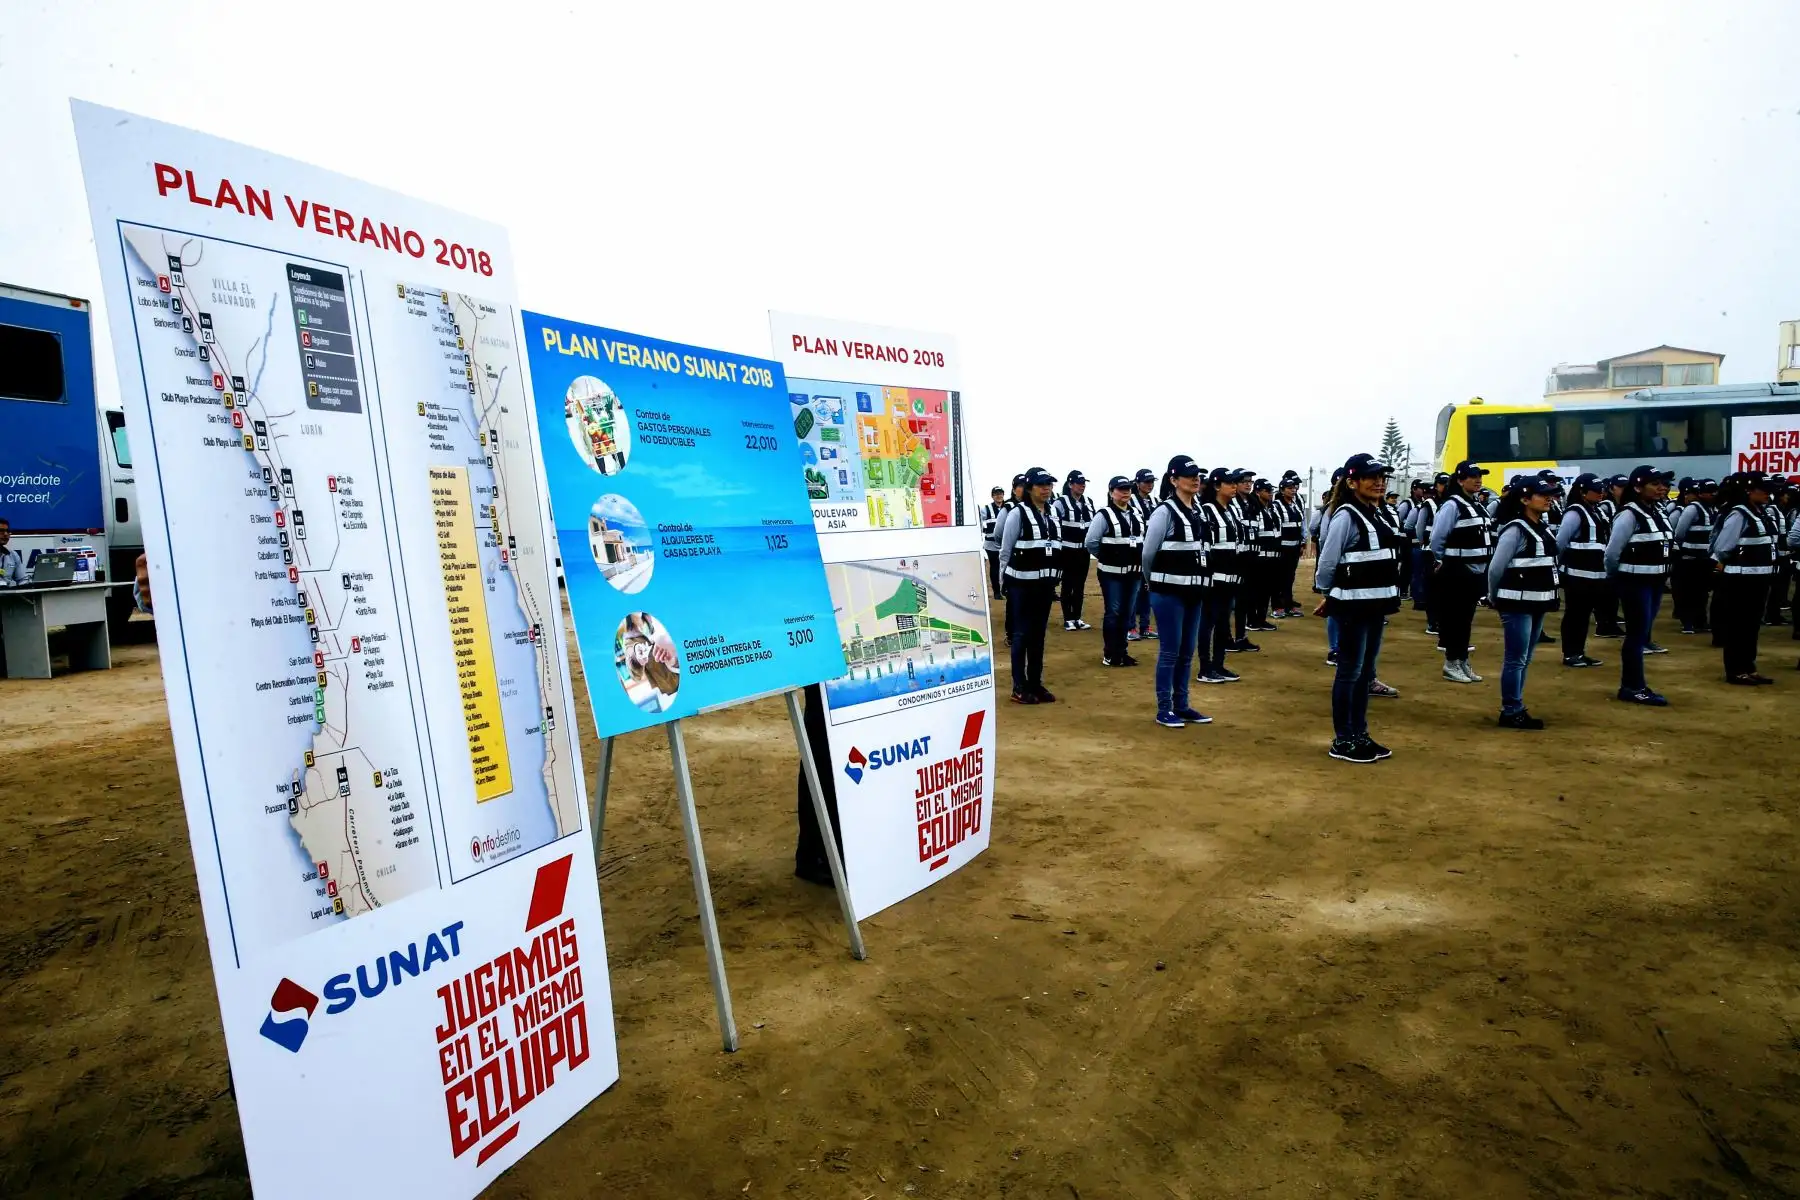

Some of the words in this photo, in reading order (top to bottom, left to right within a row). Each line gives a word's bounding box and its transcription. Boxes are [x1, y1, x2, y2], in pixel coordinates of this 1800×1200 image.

[154, 162, 274, 221] PLAN
[284, 195, 425, 258] VERANO
[433, 238, 494, 277] 2018
[212, 278, 238, 292] VILLA
[241, 283, 251, 294] EL
[212, 292, 256, 309] SALVADOR
[154, 318, 180, 329] Barlovento
[204, 331, 211, 339] 21
[542, 327, 599, 360] PLAN
[601, 339, 681, 374] VERANO
[683, 355, 738, 383] SUNAT
[740, 364, 774, 388] 2018
[792, 335, 838, 356] PLAN
[842, 341, 909, 363] VERANO
[913, 350, 945, 368] 2018
[161, 393, 174, 403] Club
[175, 393, 189, 405] Playa
[207, 414, 216, 424] San
[217, 415, 231, 424] Pedro
[635, 408, 660, 421] Control
[661, 411, 671, 421] de
[637, 422, 667, 433] GASTOS
[668, 424, 711, 437] PERSONALES
[741, 420, 775, 430] Intervenciones
[203, 438, 215, 447] Club
[216, 437, 229, 448] Playa
[259, 438, 266, 447] 34
[640, 434, 651, 444] NO
[653, 435, 696, 448] DEDUCIBLES
[744, 434, 778, 452] 22,010
[6, 491, 50, 503] crecer!
[245, 488, 253, 497] Los
[250, 515, 255, 523] El
[255, 515, 272, 523] Silencio
[828, 520, 847, 529] ASIA
[658, 523, 682, 533] Control
[683, 523, 693, 533] de
[661, 535, 702, 546] ALQUILERES
[704, 534, 714, 544] DE
[765, 535, 788, 552] 1,125
[664, 548, 687, 558] CASAS
[688, 547, 698, 557] DE
[699, 546, 722, 556] PLAYA
[255, 572, 269, 580] Punta
[251, 618, 264, 629] Playa
[783, 614, 815, 625] Intervenciones
[683, 635, 707, 649] Control
[708, 635, 718, 645] de
[718, 634, 725, 644] la
[786, 629, 814, 649] 3,010
[686, 648, 715, 662] EMISIÓN
[714, 648, 721, 657] Y
[722, 642, 752, 657] ENTREGA
[753, 640, 762, 650] DE
[689, 656, 745, 675] COMPROBANTES
[745, 654, 754, 665] DE
[754, 650, 773, 664] PAGO
[256, 682, 271, 691] Centro
[272, 678, 295, 688] Recreativo
[898, 689, 941, 707] CONDOMINIOS
[942, 688, 947, 697] Y
[947, 685, 966, 695] CASAS
[966, 683, 974, 691] DE
[974, 678, 990, 689] PLAYA
[289, 697, 300, 706] Santa
[287, 713, 314, 725] Embajadores
[868, 735, 931, 770] SUNAT
[915, 747, 983, 799] JUGAMOS
[916, 797, 931, 822] EN
[934, 792, 948, 815] EL
[951, 776, 983, 809] MISMO
[265, 803, 287, 815] Pucusana
[917, 797, 982, 863] EQUIPO
[311, 909, 322, 919] Lapa
[322, 905, 333, 917] Lapa
[323, 920, 464, 1015] SUNAT
[435, 918, 579, 1044] JUGAMOS
[439, 1038, 473, 1085] EN
[477, 1016, 508, 1060] EL
[512, 965, 584, 1038] MISMO
[444, 1001, 590, 1159] EQUIPO
